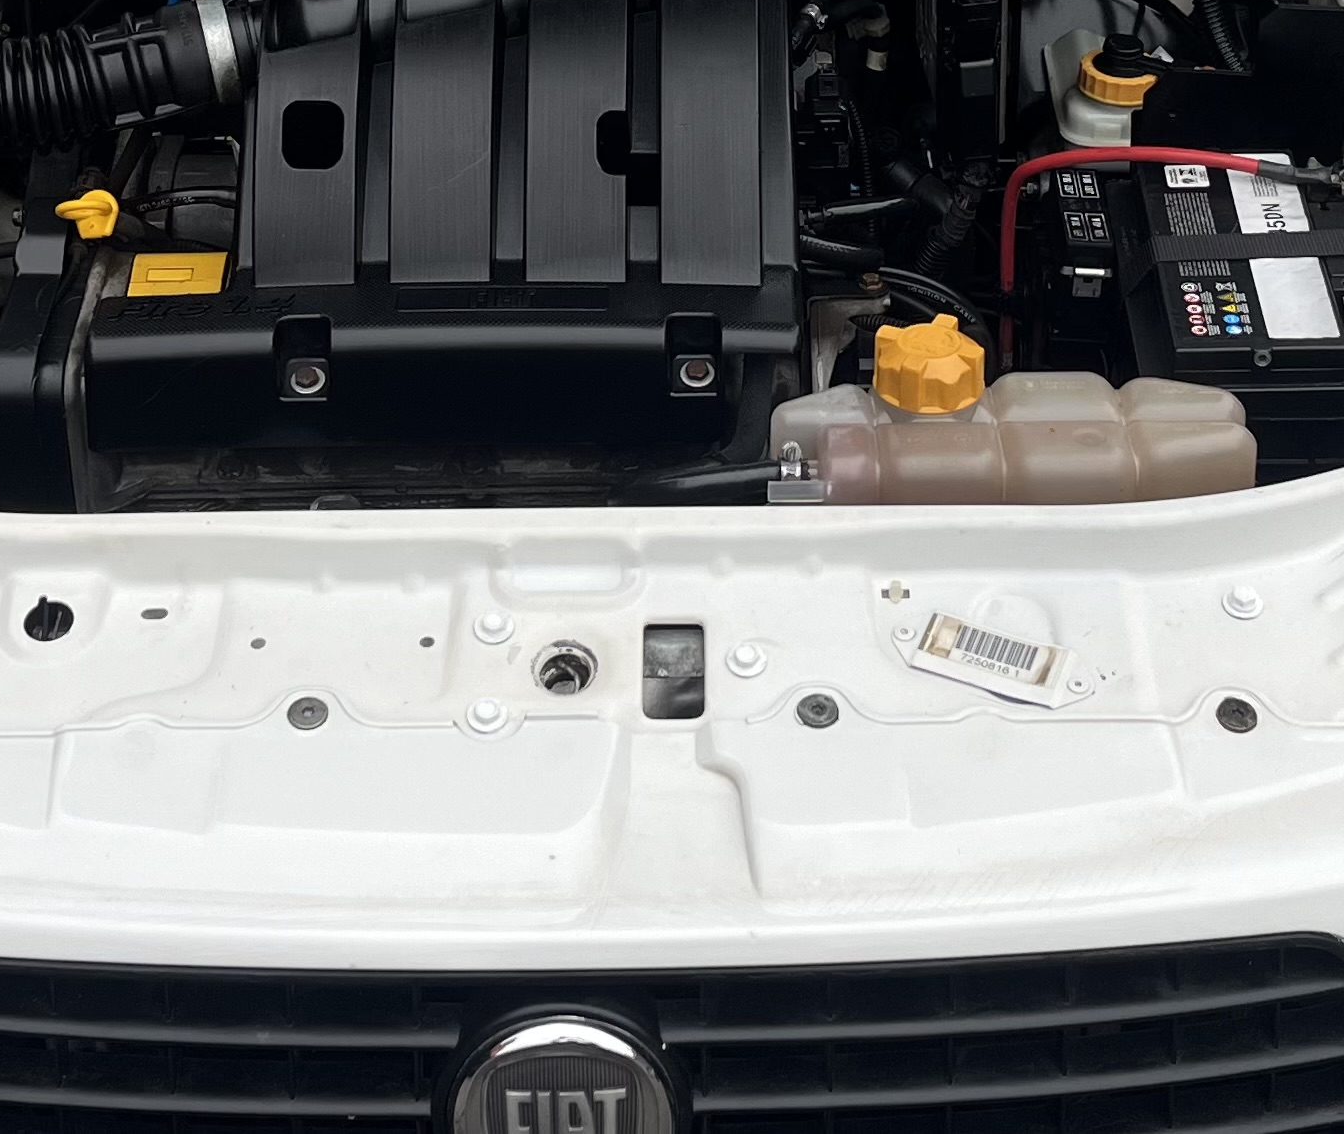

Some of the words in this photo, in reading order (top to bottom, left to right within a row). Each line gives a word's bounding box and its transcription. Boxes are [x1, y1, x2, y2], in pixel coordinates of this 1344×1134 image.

[1261, 203, 1286, 233] 5DN
[907, 286, 947, 303] IGNITION
[953, 304, 976, 323] CABLE
[959, 652, 1010, 675] 7250816
[504, 1087, 627, 1134] FIAT
